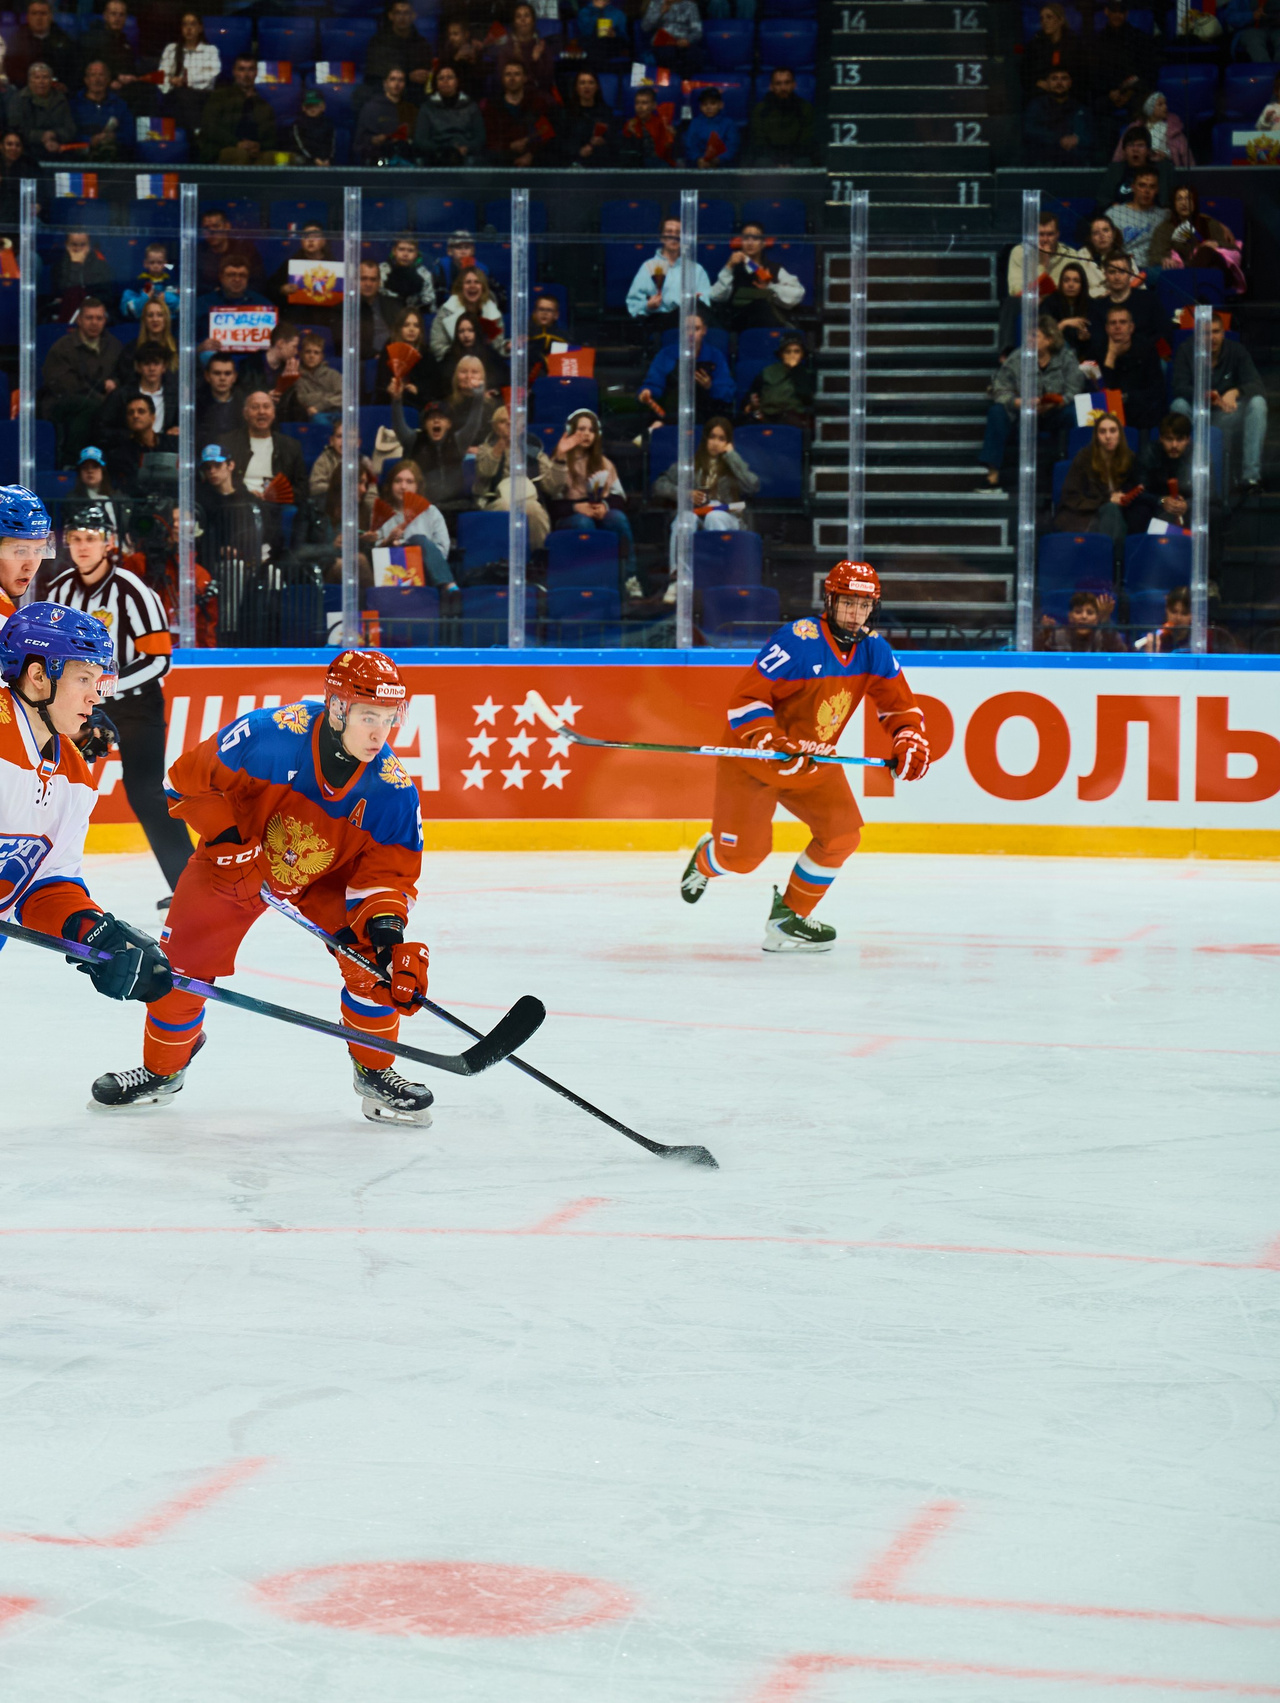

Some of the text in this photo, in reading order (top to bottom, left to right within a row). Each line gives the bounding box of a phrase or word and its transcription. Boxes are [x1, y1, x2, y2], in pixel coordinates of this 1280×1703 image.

[841, 9, 867, 32] 14
[953, 8, 980, 32] 14
[834, 63, 862, 85] 13
[954, 63, 983, 85] 13
[831, 123, 858, 145] 12
[953, 121, 982, 145] 12
[957, 181, 981, 206] 11
[24, 638, 50, 648] CCM
[759, 644, 791, 673] 27
[376, 686, 405, 696] РОЛЬФ
[221, 718, 251, 753] 15
[348, 798, 367, 828] A
[216, 843, 263, 866] CCM
[87, 921, 108, 943] CCM
[396, 985, 413, 993] CCM
